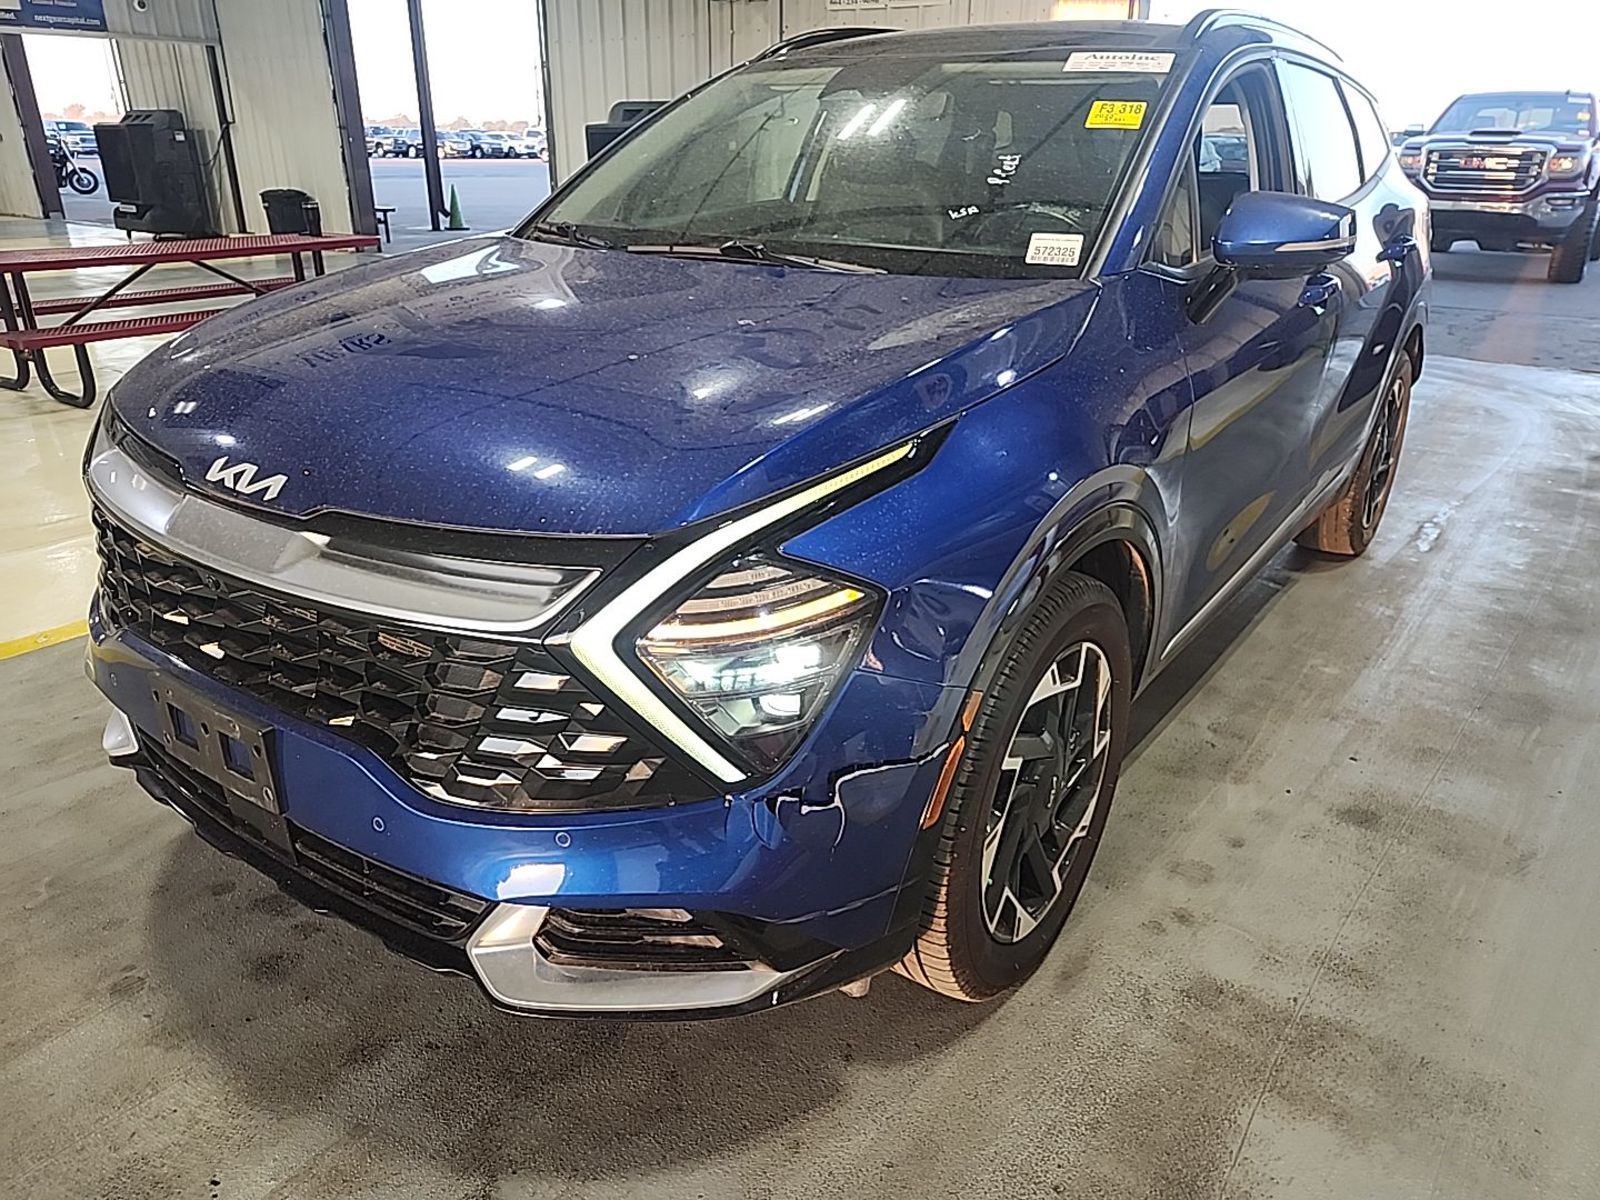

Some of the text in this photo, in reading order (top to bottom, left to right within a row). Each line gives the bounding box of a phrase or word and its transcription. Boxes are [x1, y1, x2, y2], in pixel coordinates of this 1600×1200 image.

[1118, 104, 1143, 114] 318
[1033, 246, 1076, 257] 572325
[205, 456, 289, 501] KIA
